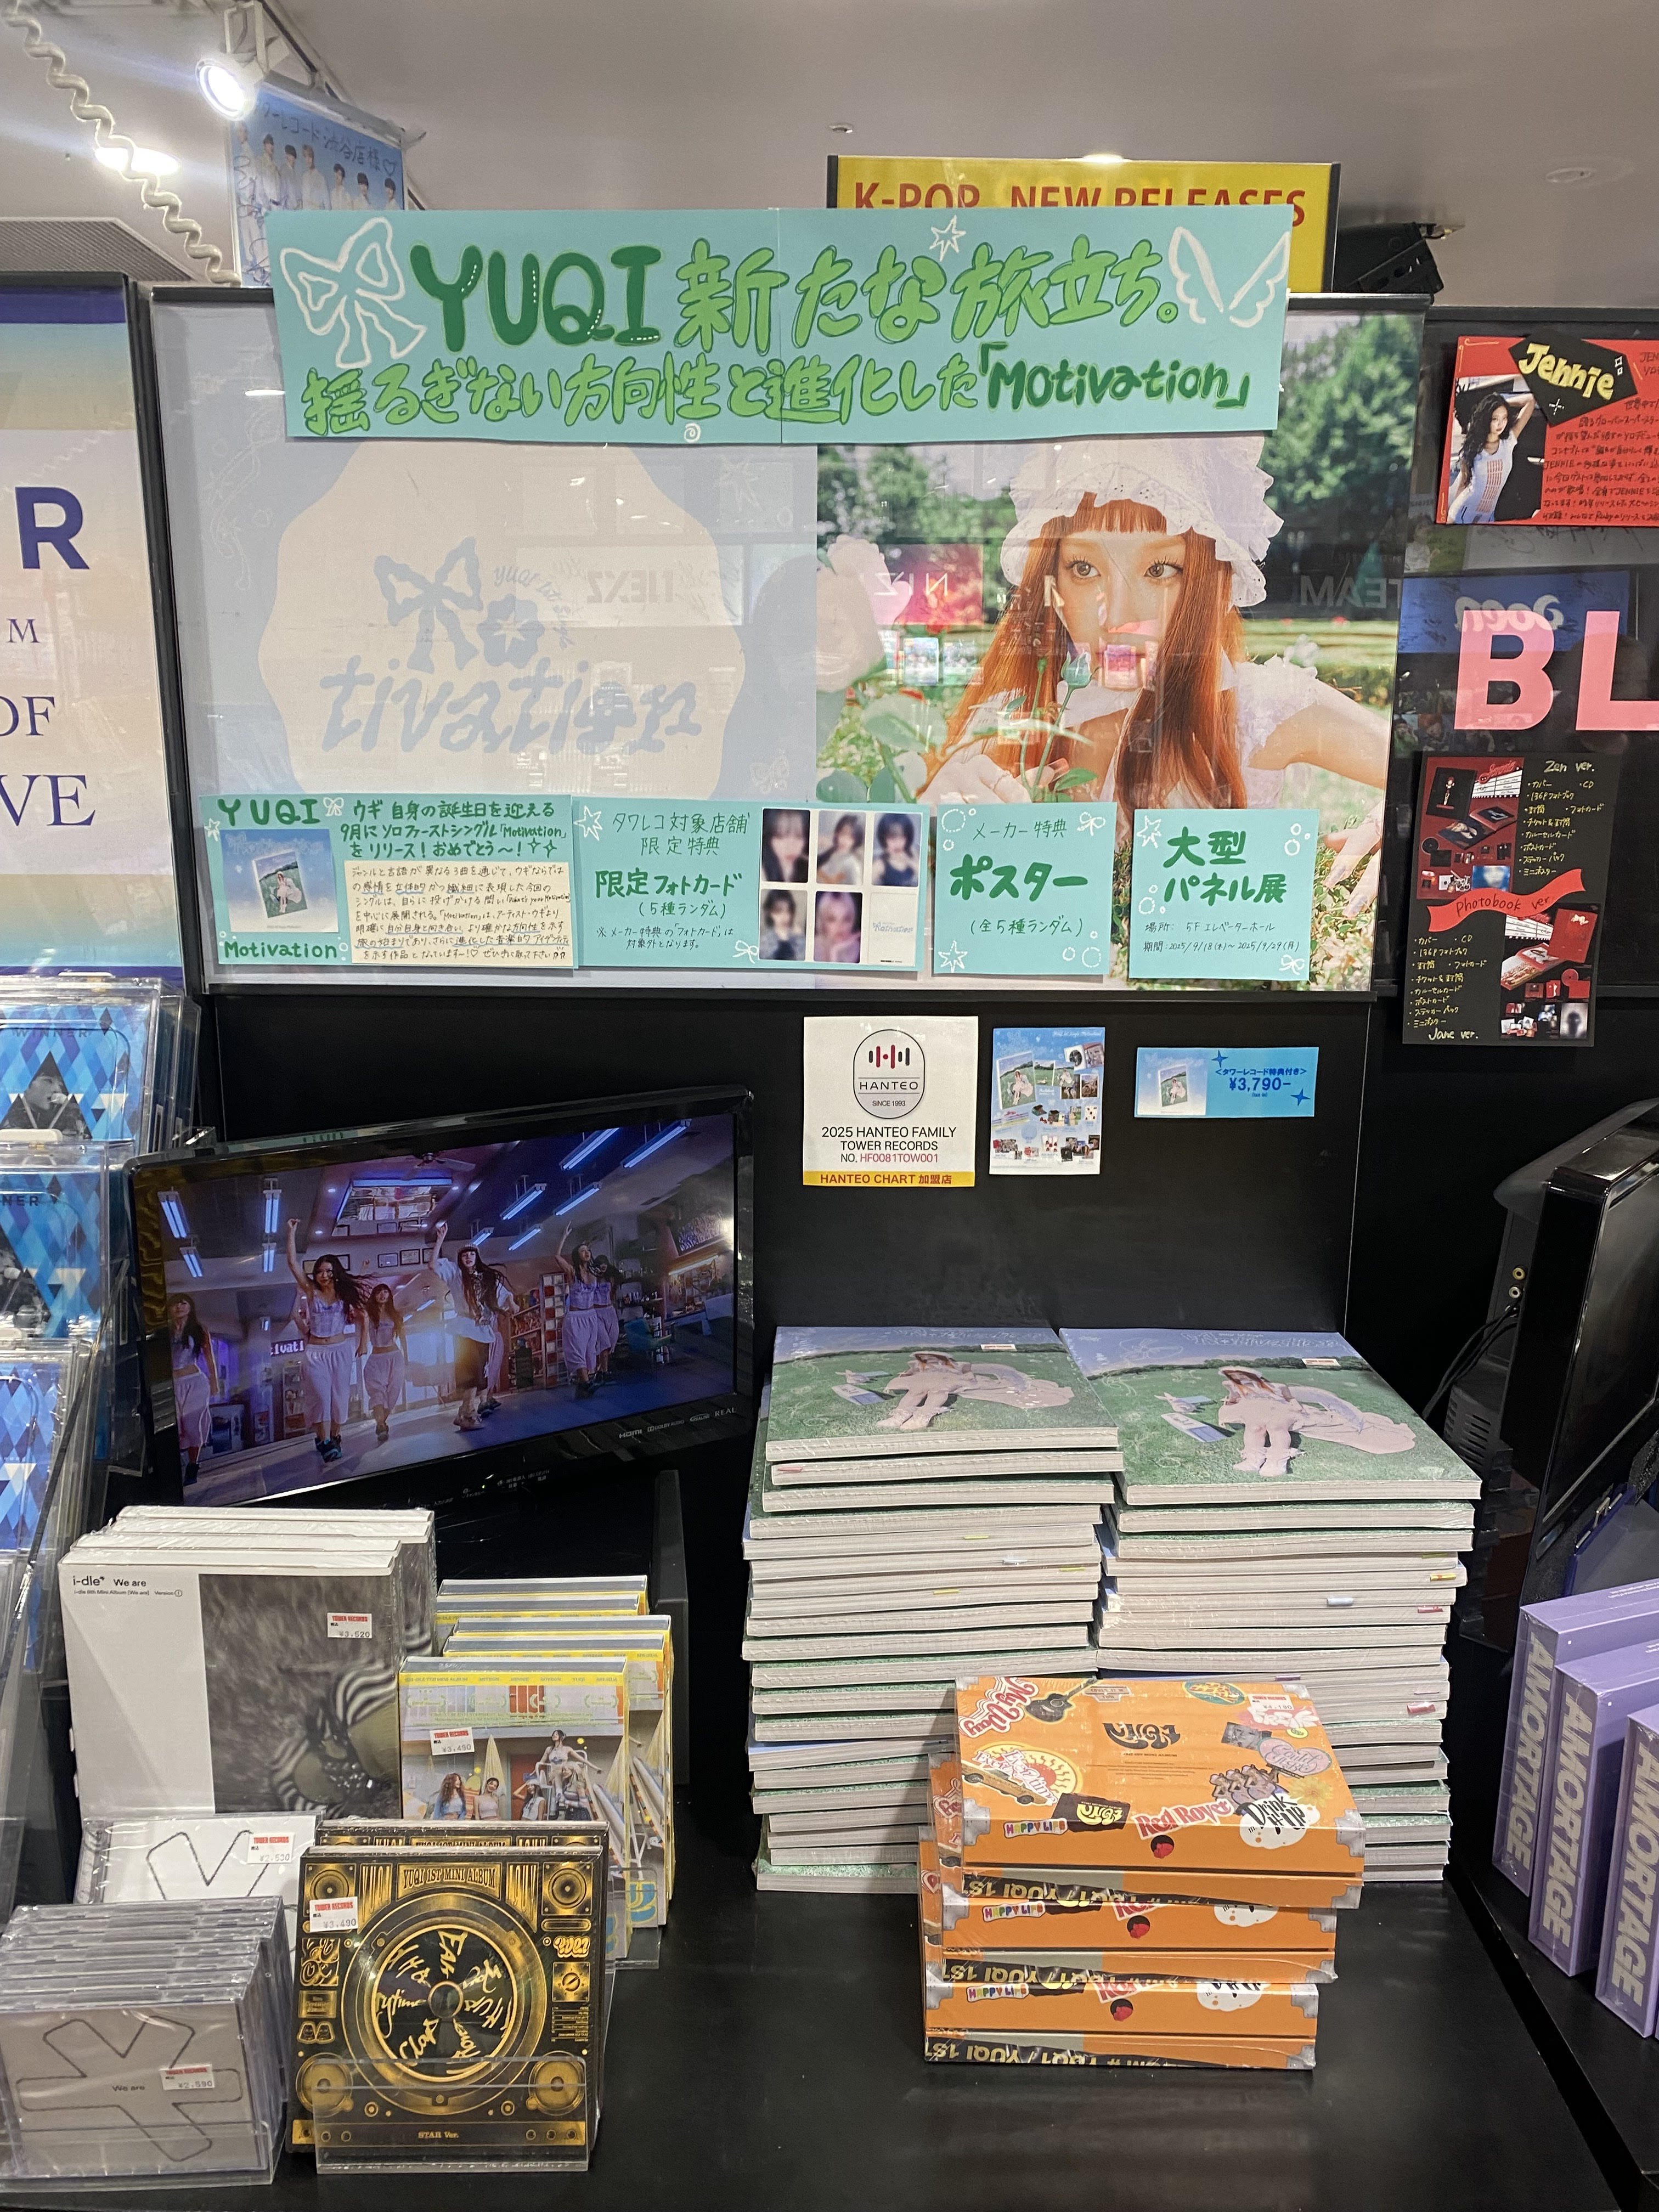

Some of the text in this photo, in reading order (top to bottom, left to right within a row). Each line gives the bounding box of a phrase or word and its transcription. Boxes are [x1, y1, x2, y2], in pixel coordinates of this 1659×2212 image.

[1012, 185, 1102, 207] NEW
[409, 244, 662, 353] YUQI
[1518, 343, 1615, 401] Jennie
[15, 487, 90, 570] R
[1454, 610, 1659, 732] BL
[1543, 760, 1567, 773] Zen
[217, 798, 321, 827] YUQI
[973, 818, 1068, 840] メーカー特典
[641, 836, 720, 857] 限定特典
[1163, 826, 1247, 868] 大型
[595, 867, 743, 899] 限定フォトカード
[949, 853, 1089, 901] ポスター
[1164, 872, 1288, 906] パネル展
[224, 941, 337, 958] Motivation
[860, 1081, 918, 1090] HANTEO
[821, 1126, 957, 1138] 2025 HANTEO FAMILY
[840, 1141, 939, 1150] TOWER RECORDS
[840, 1153, 858, 1163] NO.
[820, 1173, 952, 1184] HANTEO CHART 加盟店
[715, 1407, 737, 1417] REAL
[113, 1578, 129, 1587] We
[1506, 1631, 1554, 1870] AMORTAGE
[1542, 1691, 1594, 1949] AMORTAGE
[1611, 1741, 1659, 2008] AMORTAGE
